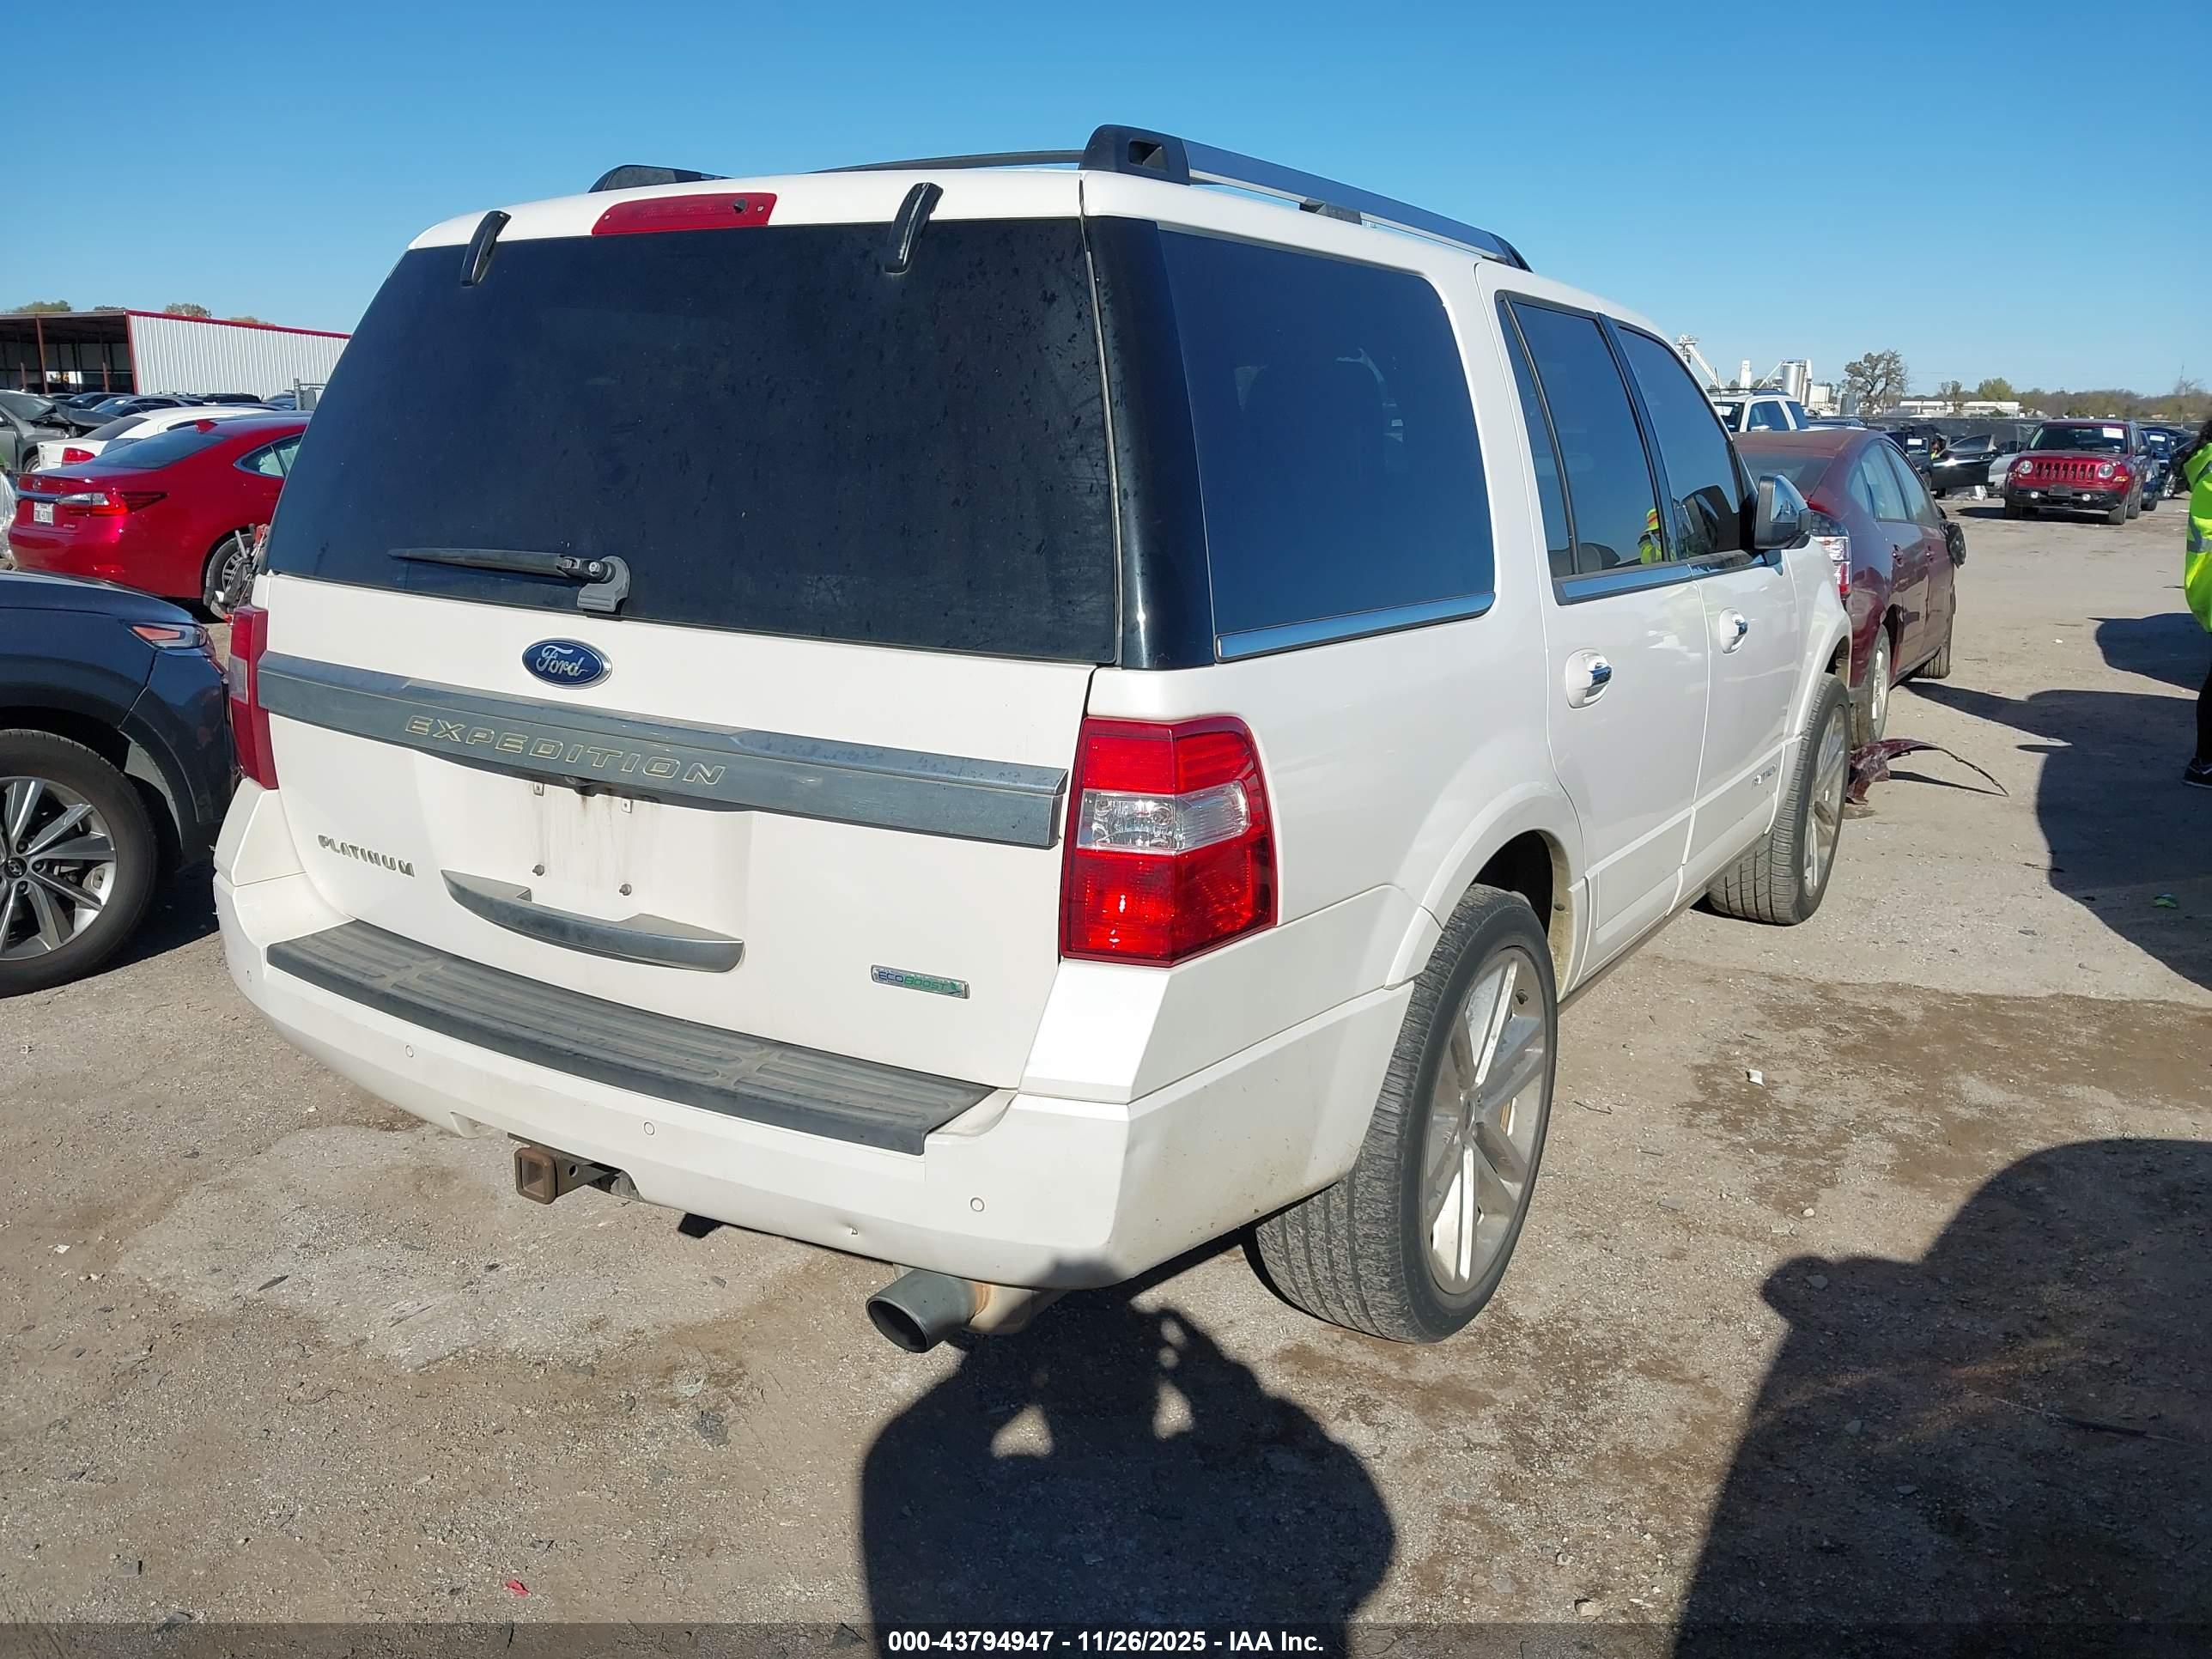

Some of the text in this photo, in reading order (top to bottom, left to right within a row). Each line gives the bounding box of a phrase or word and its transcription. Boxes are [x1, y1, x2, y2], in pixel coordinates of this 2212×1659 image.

[536, 645, 588, 677] Ford
[404, 714, 726, 786] EXPEDITION
[317, 834, 416, 878] PLATINUM
